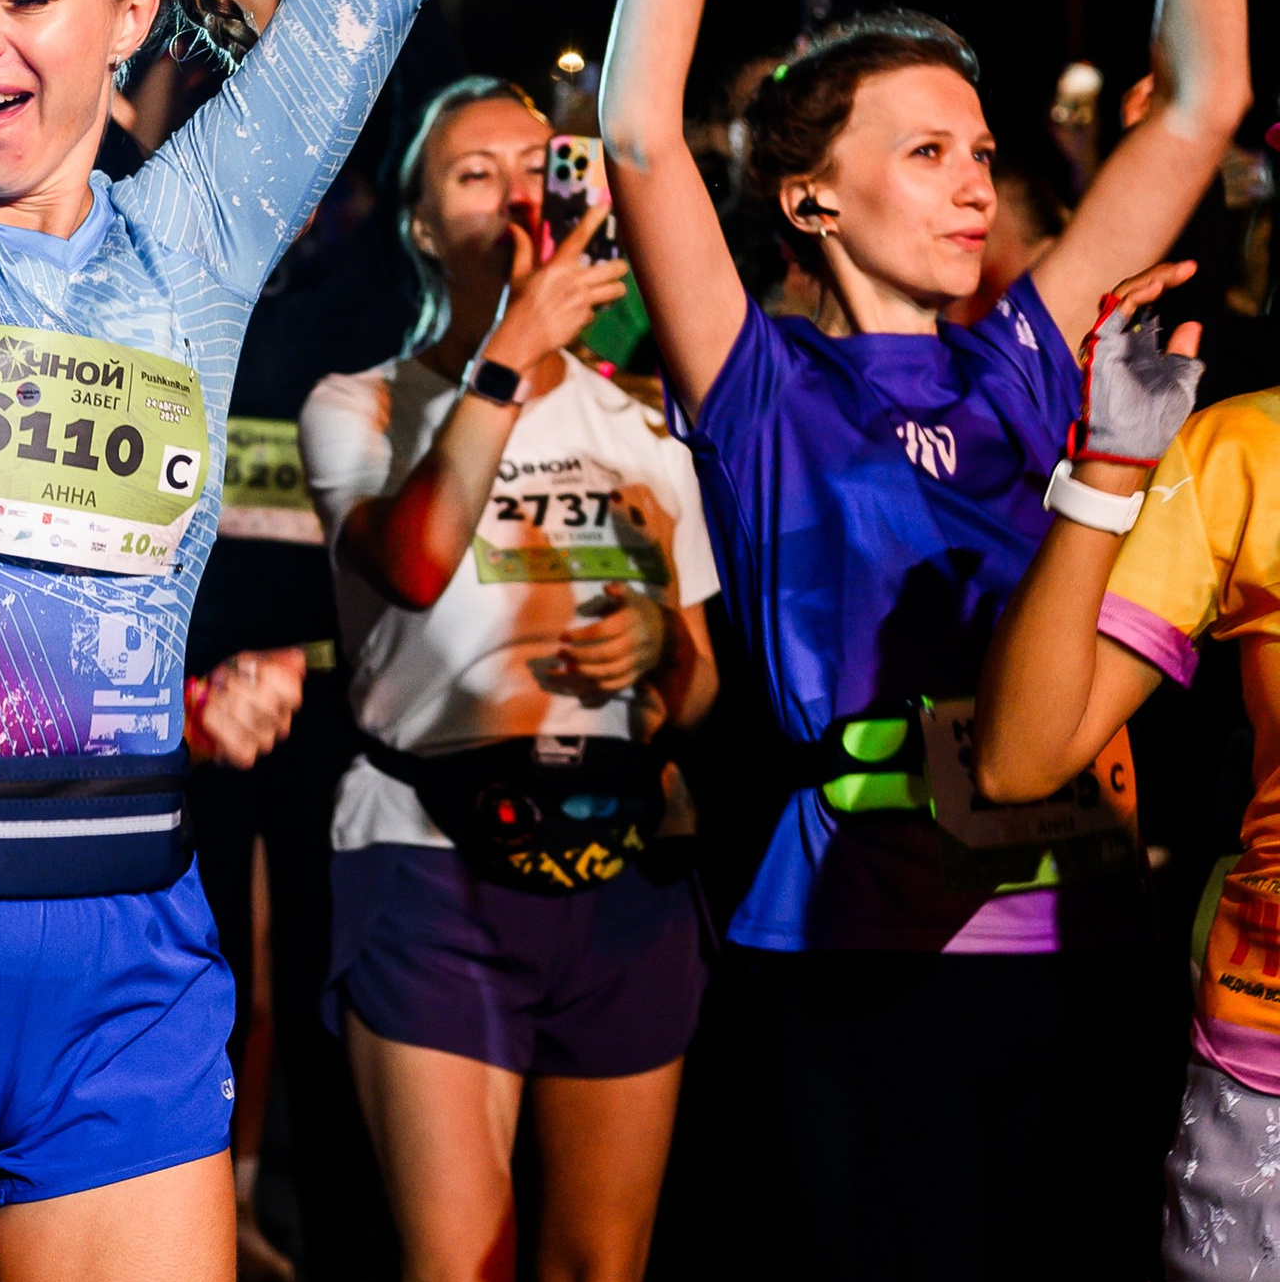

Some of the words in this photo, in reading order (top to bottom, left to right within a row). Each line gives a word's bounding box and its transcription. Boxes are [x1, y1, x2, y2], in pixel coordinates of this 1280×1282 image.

[140, 371, 191, 395] PushkinRun
[71, 389, 122, 410] ЗАБЕГ
[145, 397, 157, 408] 24
[159, 401, 191, 416] АВГУСТА
[160, 411, 181, 424] 2024
[41, 482, 97, 508] АННА
[493, 491, 611, 527] 2737
[120, 532, 151, 556] 10
